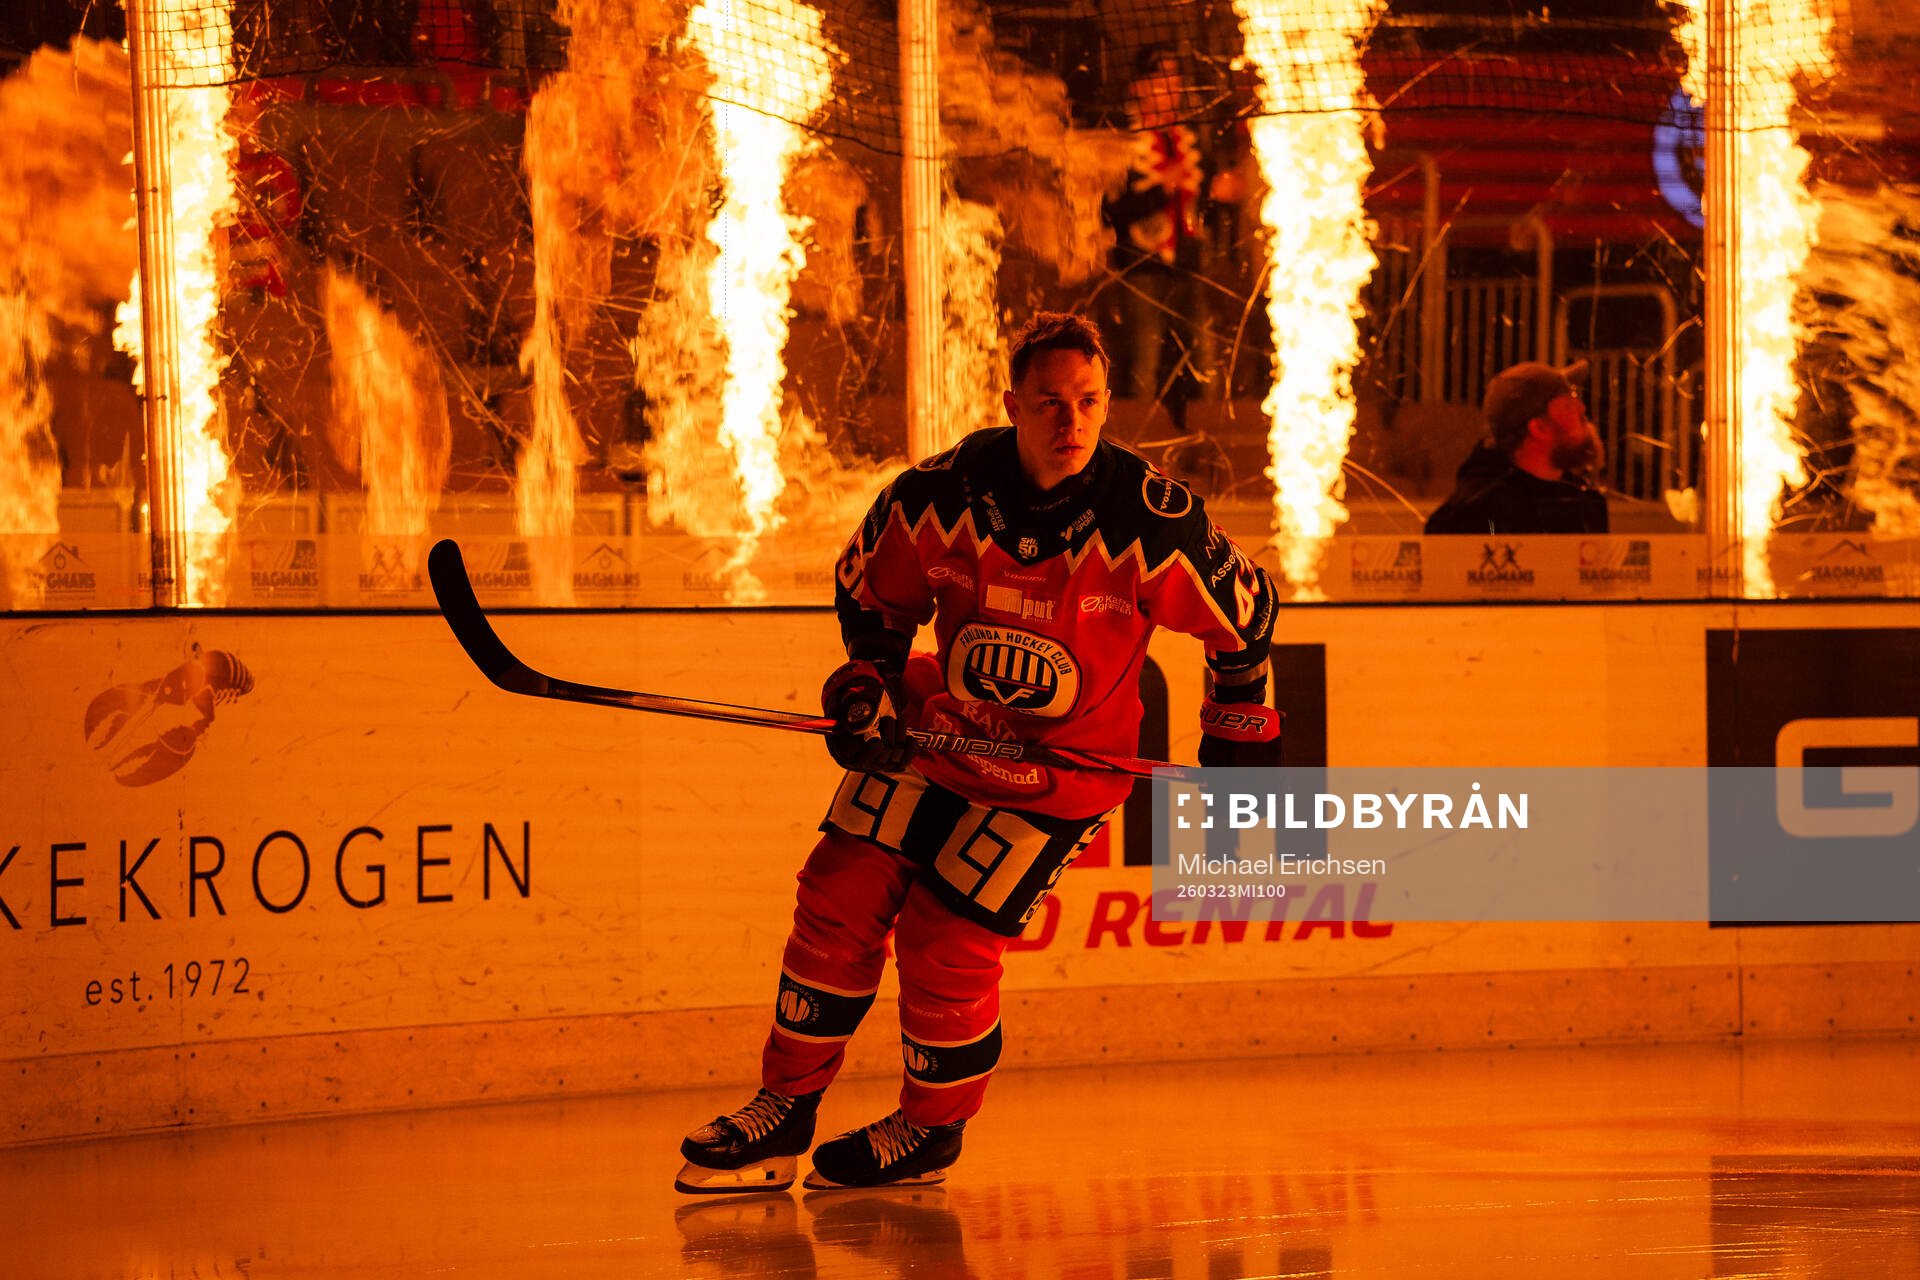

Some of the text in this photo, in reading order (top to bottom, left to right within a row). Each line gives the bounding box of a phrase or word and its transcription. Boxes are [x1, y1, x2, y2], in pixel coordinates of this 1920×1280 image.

[34, 572, 96, 589] GMANS
[251, 571, 319, 587] HAGMANS
[470, 572, 532, 587] AGMANS
[573, 572, 640, 587] HAGMANS
[1467, 569, 1535, 585] HAGMANS
[1006, 632, 1053, 654] HOCKEY
[1050, 651, 1073, 675] CLUB
[1084, 882, 1395, 949] RENTAL
